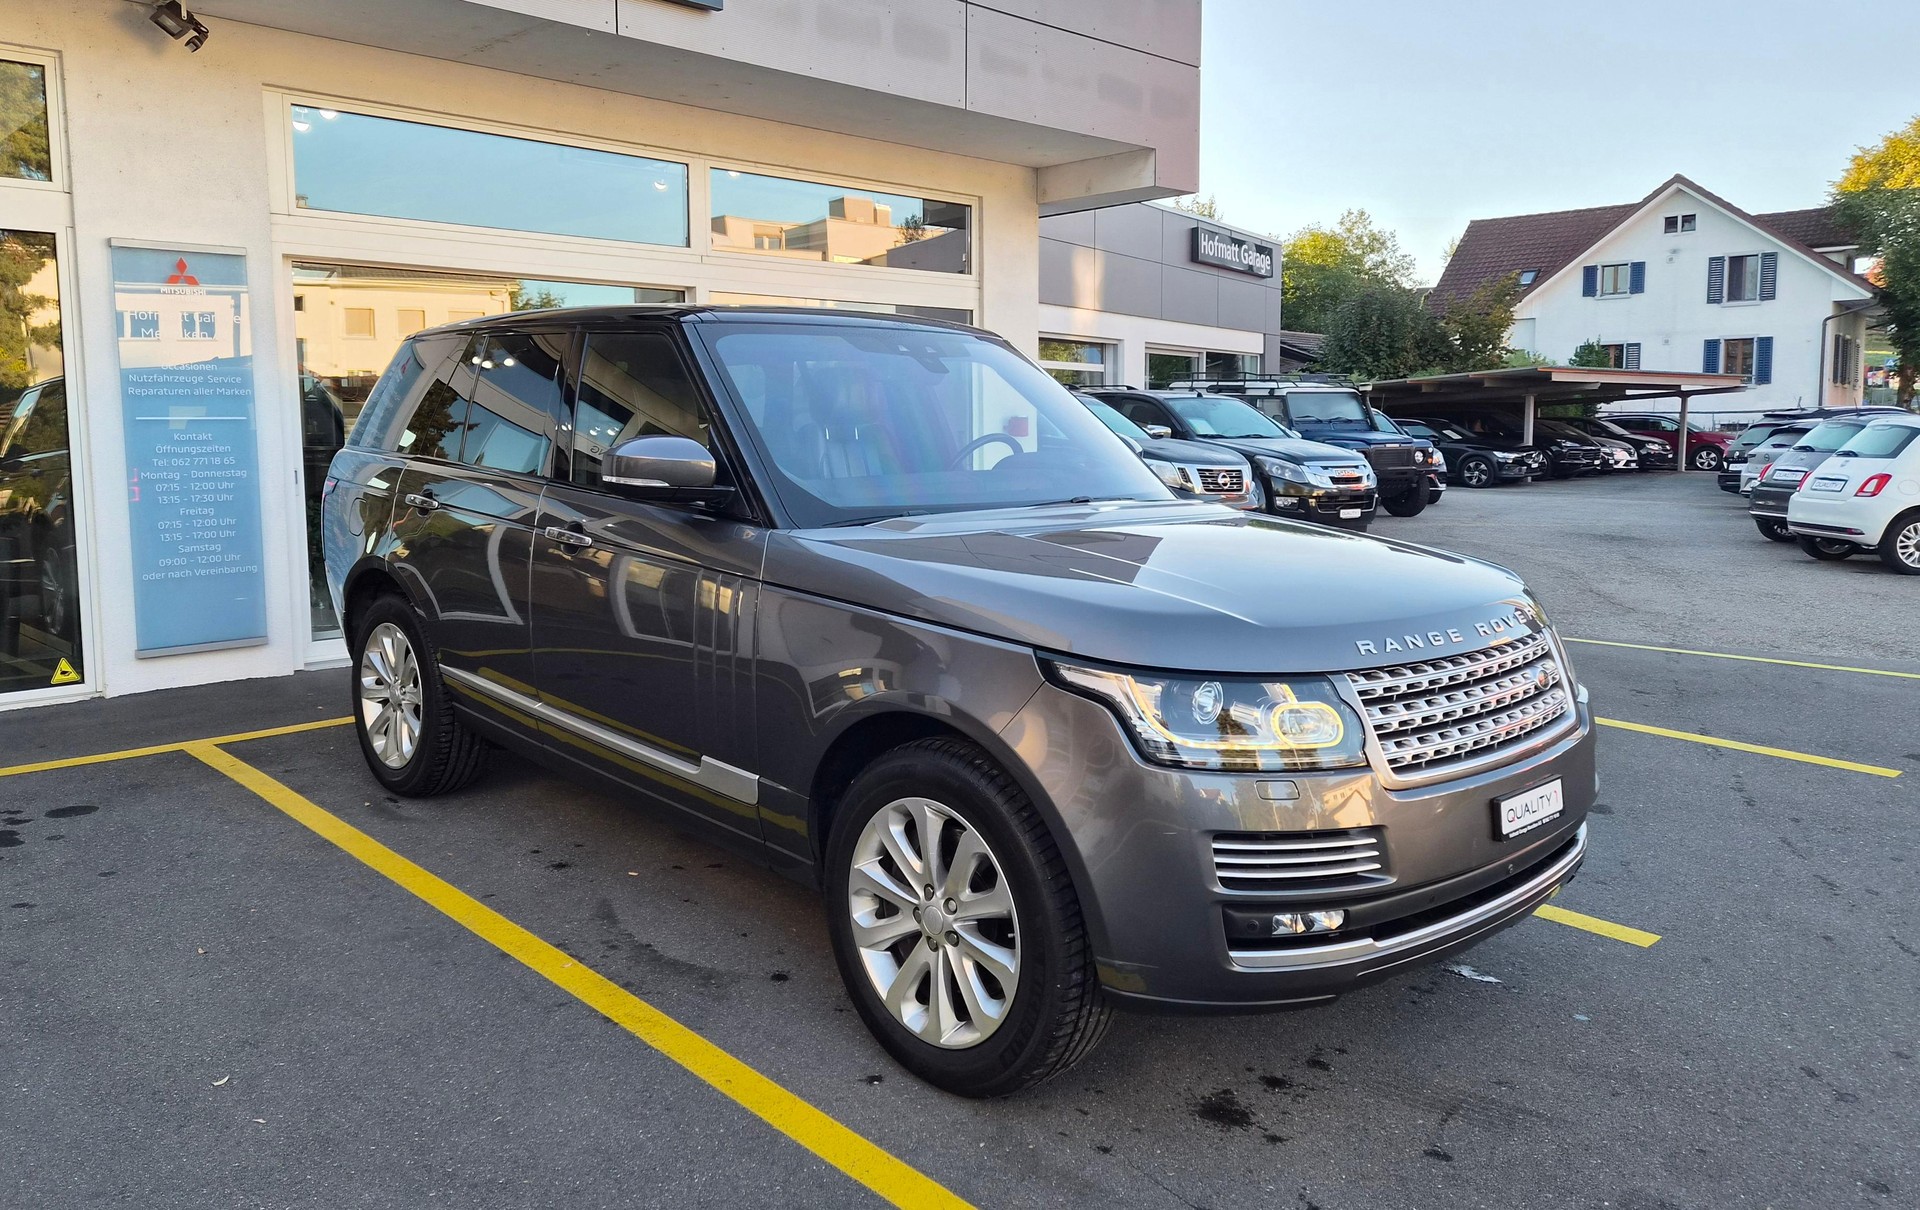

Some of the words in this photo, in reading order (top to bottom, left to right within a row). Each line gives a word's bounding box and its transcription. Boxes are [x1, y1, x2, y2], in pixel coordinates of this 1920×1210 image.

[1201, 232, 1239, 262] Hofmatt
[1241, 245, 1271, 274] Garage
[160, 287, 206, 296] MITSUBISHI
[128, 374, 204, 385] Nutzfahrzeuge
[207, 375, 242, 384] Service
[128, 387, 191, 397] Reparaturen
[193, 387, 214, 396] aller
[216, 387, 251, 396] Marken
[173, 432, 213, 441] Kontakt
[155, 444, 231, 455] Öffnungszeiten
[152, 458, 169, 467] Tel:
[171, 457, 191, 466] 062
[193, 457, 208, 466] 771
[210, 457, 221, 465] 18
[223, 456, 235, 465] 65
[140, 471, 180, 481] Montag
[191, 469, 247, 479] Donnerstag
[155, 483, 180, 492] 07:15
[190, 482, 215, 491] 12:00
[217, 481, 235, 490] Uhr
[157, 495, 181, 504] 13:15
[190, 494, 214, 502] 17:30
[216, 493, 234, 502] Uhr
[179, 507, 215, 517] Freitag
[157, 521, 182, 530] 07:15
[192, 519, 217, 528] 12:00
[219, 518, 237, 526] Uhr
[160, 533, 183, 542] 13:15
[192, 531, 217, 540] 17:00
[219, 530, 237, 538] Uhr
[178, 543, 222, 553] Samstag
[158, 558, 187, 567] 09:00
[197, 555, 222, 564] 12:00
[224, 554, 242, 562] Uhr
[142, 572, 165, 581] oder
[168, 570, 192, 579] nach
[194, 564, 258, 576] Vereinbarung
[1355, 628, 1464, 656] RANGE
[1473, 607, 1537, 637] ROVER
[1506, 792, 1552, 823] QUALITY
[1554, 789, 1558, 804] 1
